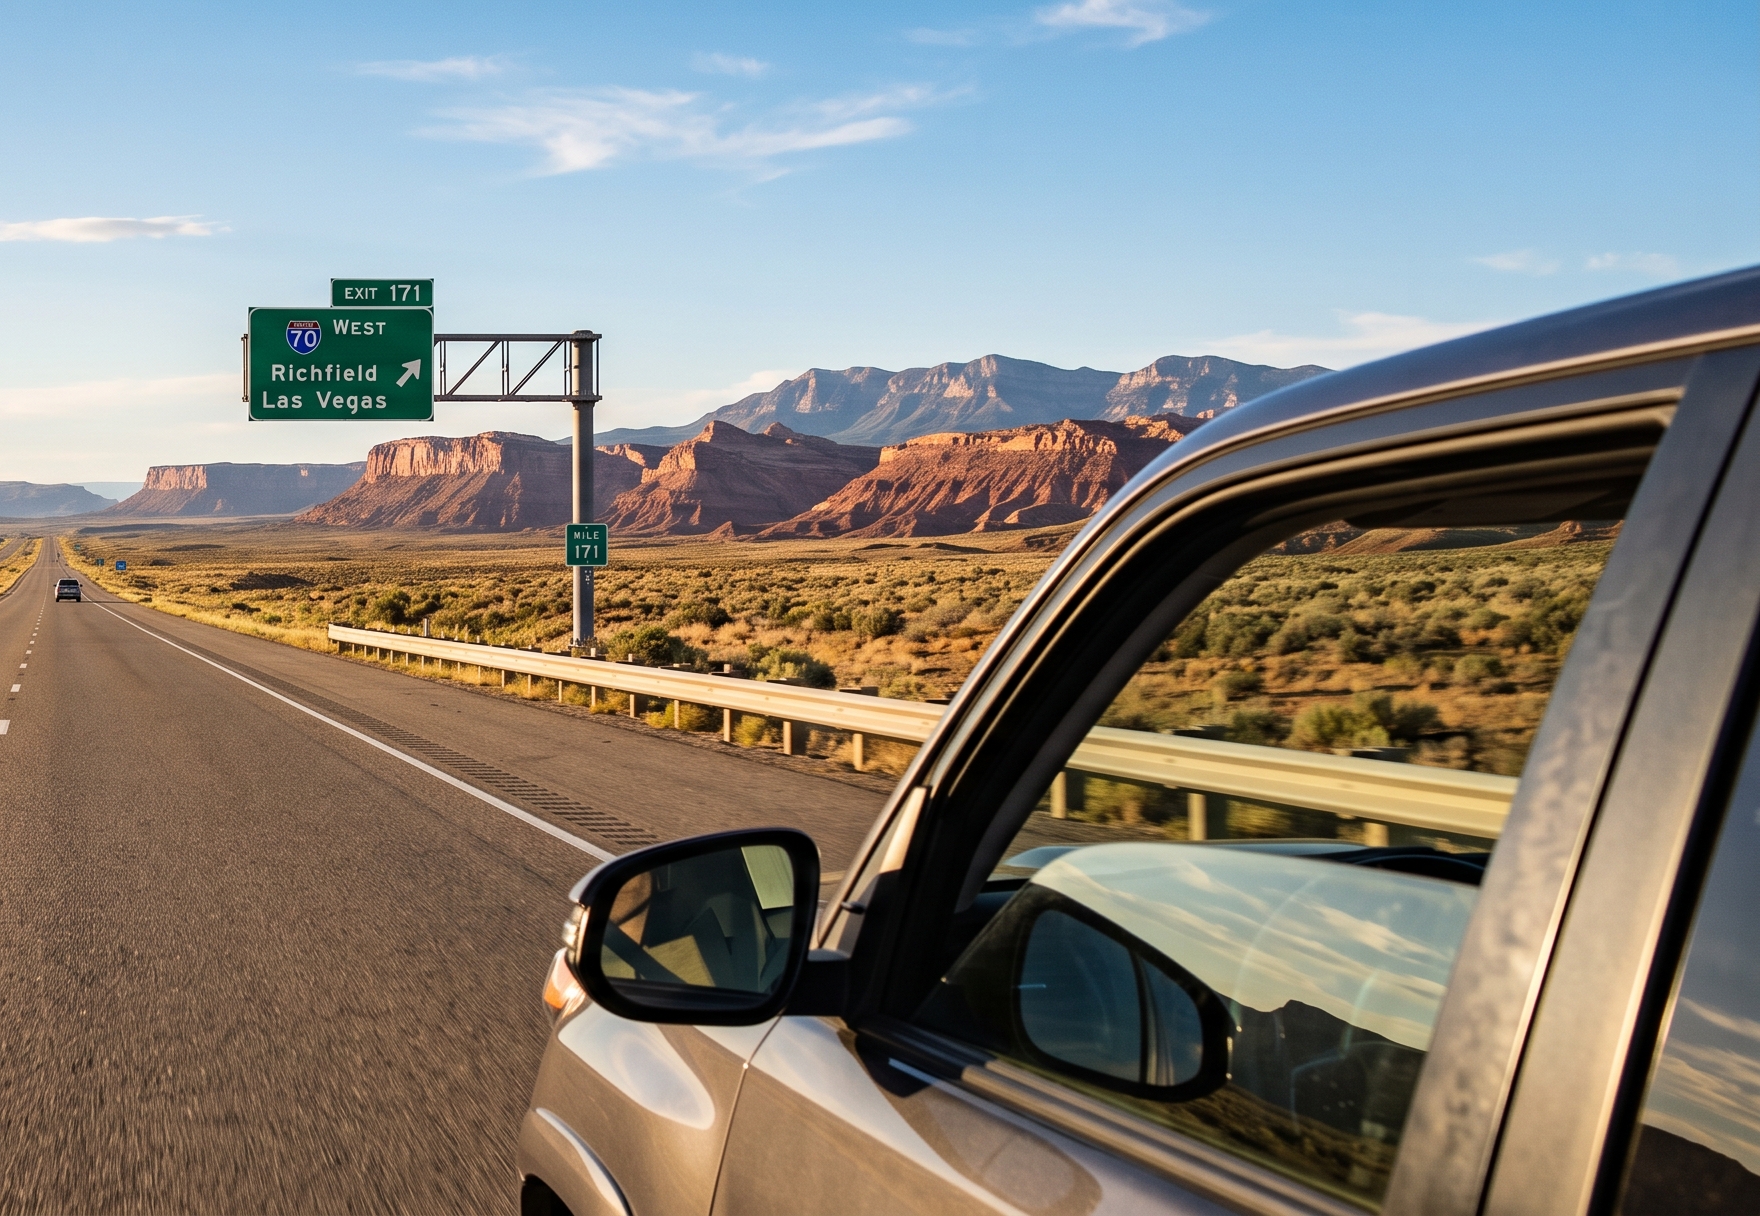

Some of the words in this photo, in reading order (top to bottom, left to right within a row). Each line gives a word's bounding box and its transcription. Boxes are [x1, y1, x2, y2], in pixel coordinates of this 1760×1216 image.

[344, 287, 378, 300] EXIT
[389, 284, 420, 302] 171
[332, 319, 386, 336] WEST
[290, 330, 317, 348] 70
[271, 364, 377, 382] Richfield
[262, 391, 303, 409] Las
[316, 391, 387, 415] Vegas
[574, 531, 599, 540] MILE
[575, 544, 598, 559] 171
